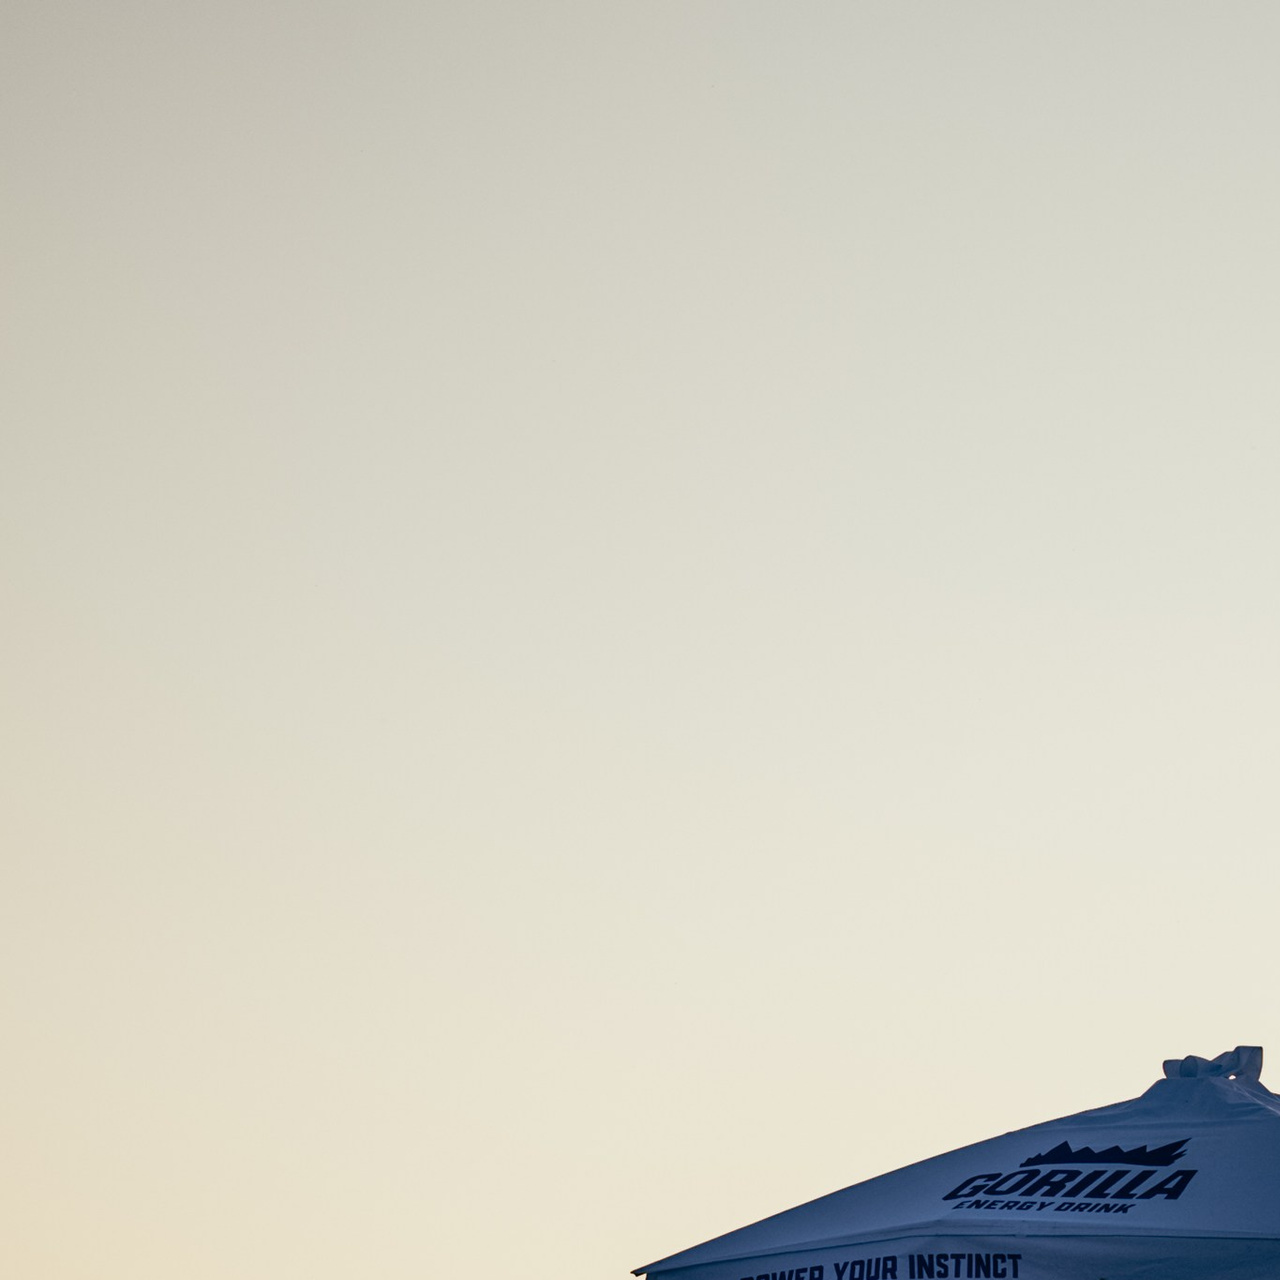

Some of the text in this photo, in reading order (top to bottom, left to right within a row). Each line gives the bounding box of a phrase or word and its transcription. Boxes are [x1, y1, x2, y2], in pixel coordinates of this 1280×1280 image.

[942, 1169, 1199, 1201] GORILLA
[952, 1200, 1137, 1214] ENERGY DRINK
[908, 1253, 1022, 1280] INSTINCT
